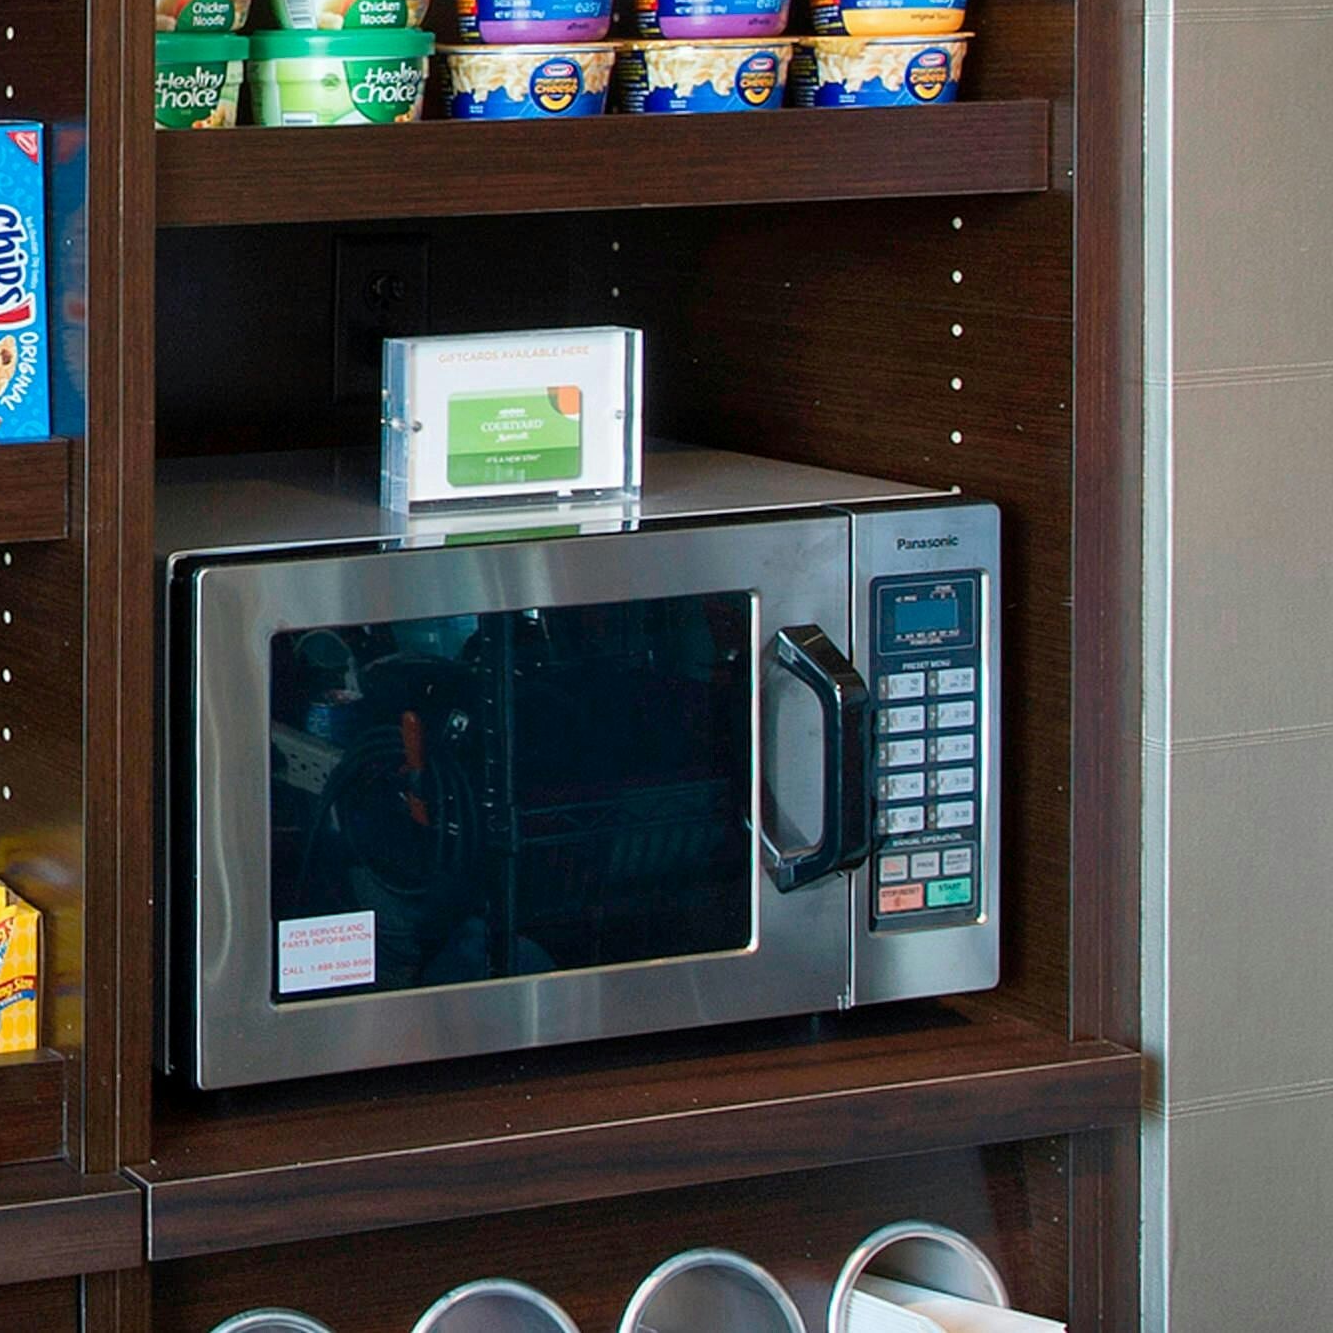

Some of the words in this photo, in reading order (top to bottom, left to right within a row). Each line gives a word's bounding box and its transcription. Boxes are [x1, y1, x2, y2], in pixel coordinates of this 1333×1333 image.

[191, 1, 230, 14] Chicken
[358, 0, 401, 13] Chicken
[192, 14, 227, 27] Noodle
[359, 13, 398, 26] Noodle
[363, 62, 423, 85] Healthy
[351, 82, 415, 104] Choice
[438, 350, 499, 363] GIFTCARDS
[501, 346, 559, 359] AVAILABLE
[561, 345, 590, 355] HERE
[0, 332, 39, 411] ORIGINAL
[481, 418, 544, 433] COURTYARD
[896, 534, 960, 551] Panasonic
[902, 660, 930, 671] PRESET
[931, 659, 952, 669] MENU
[938, 882, 963, 892] START
[9, 977, 34, 992] Size
